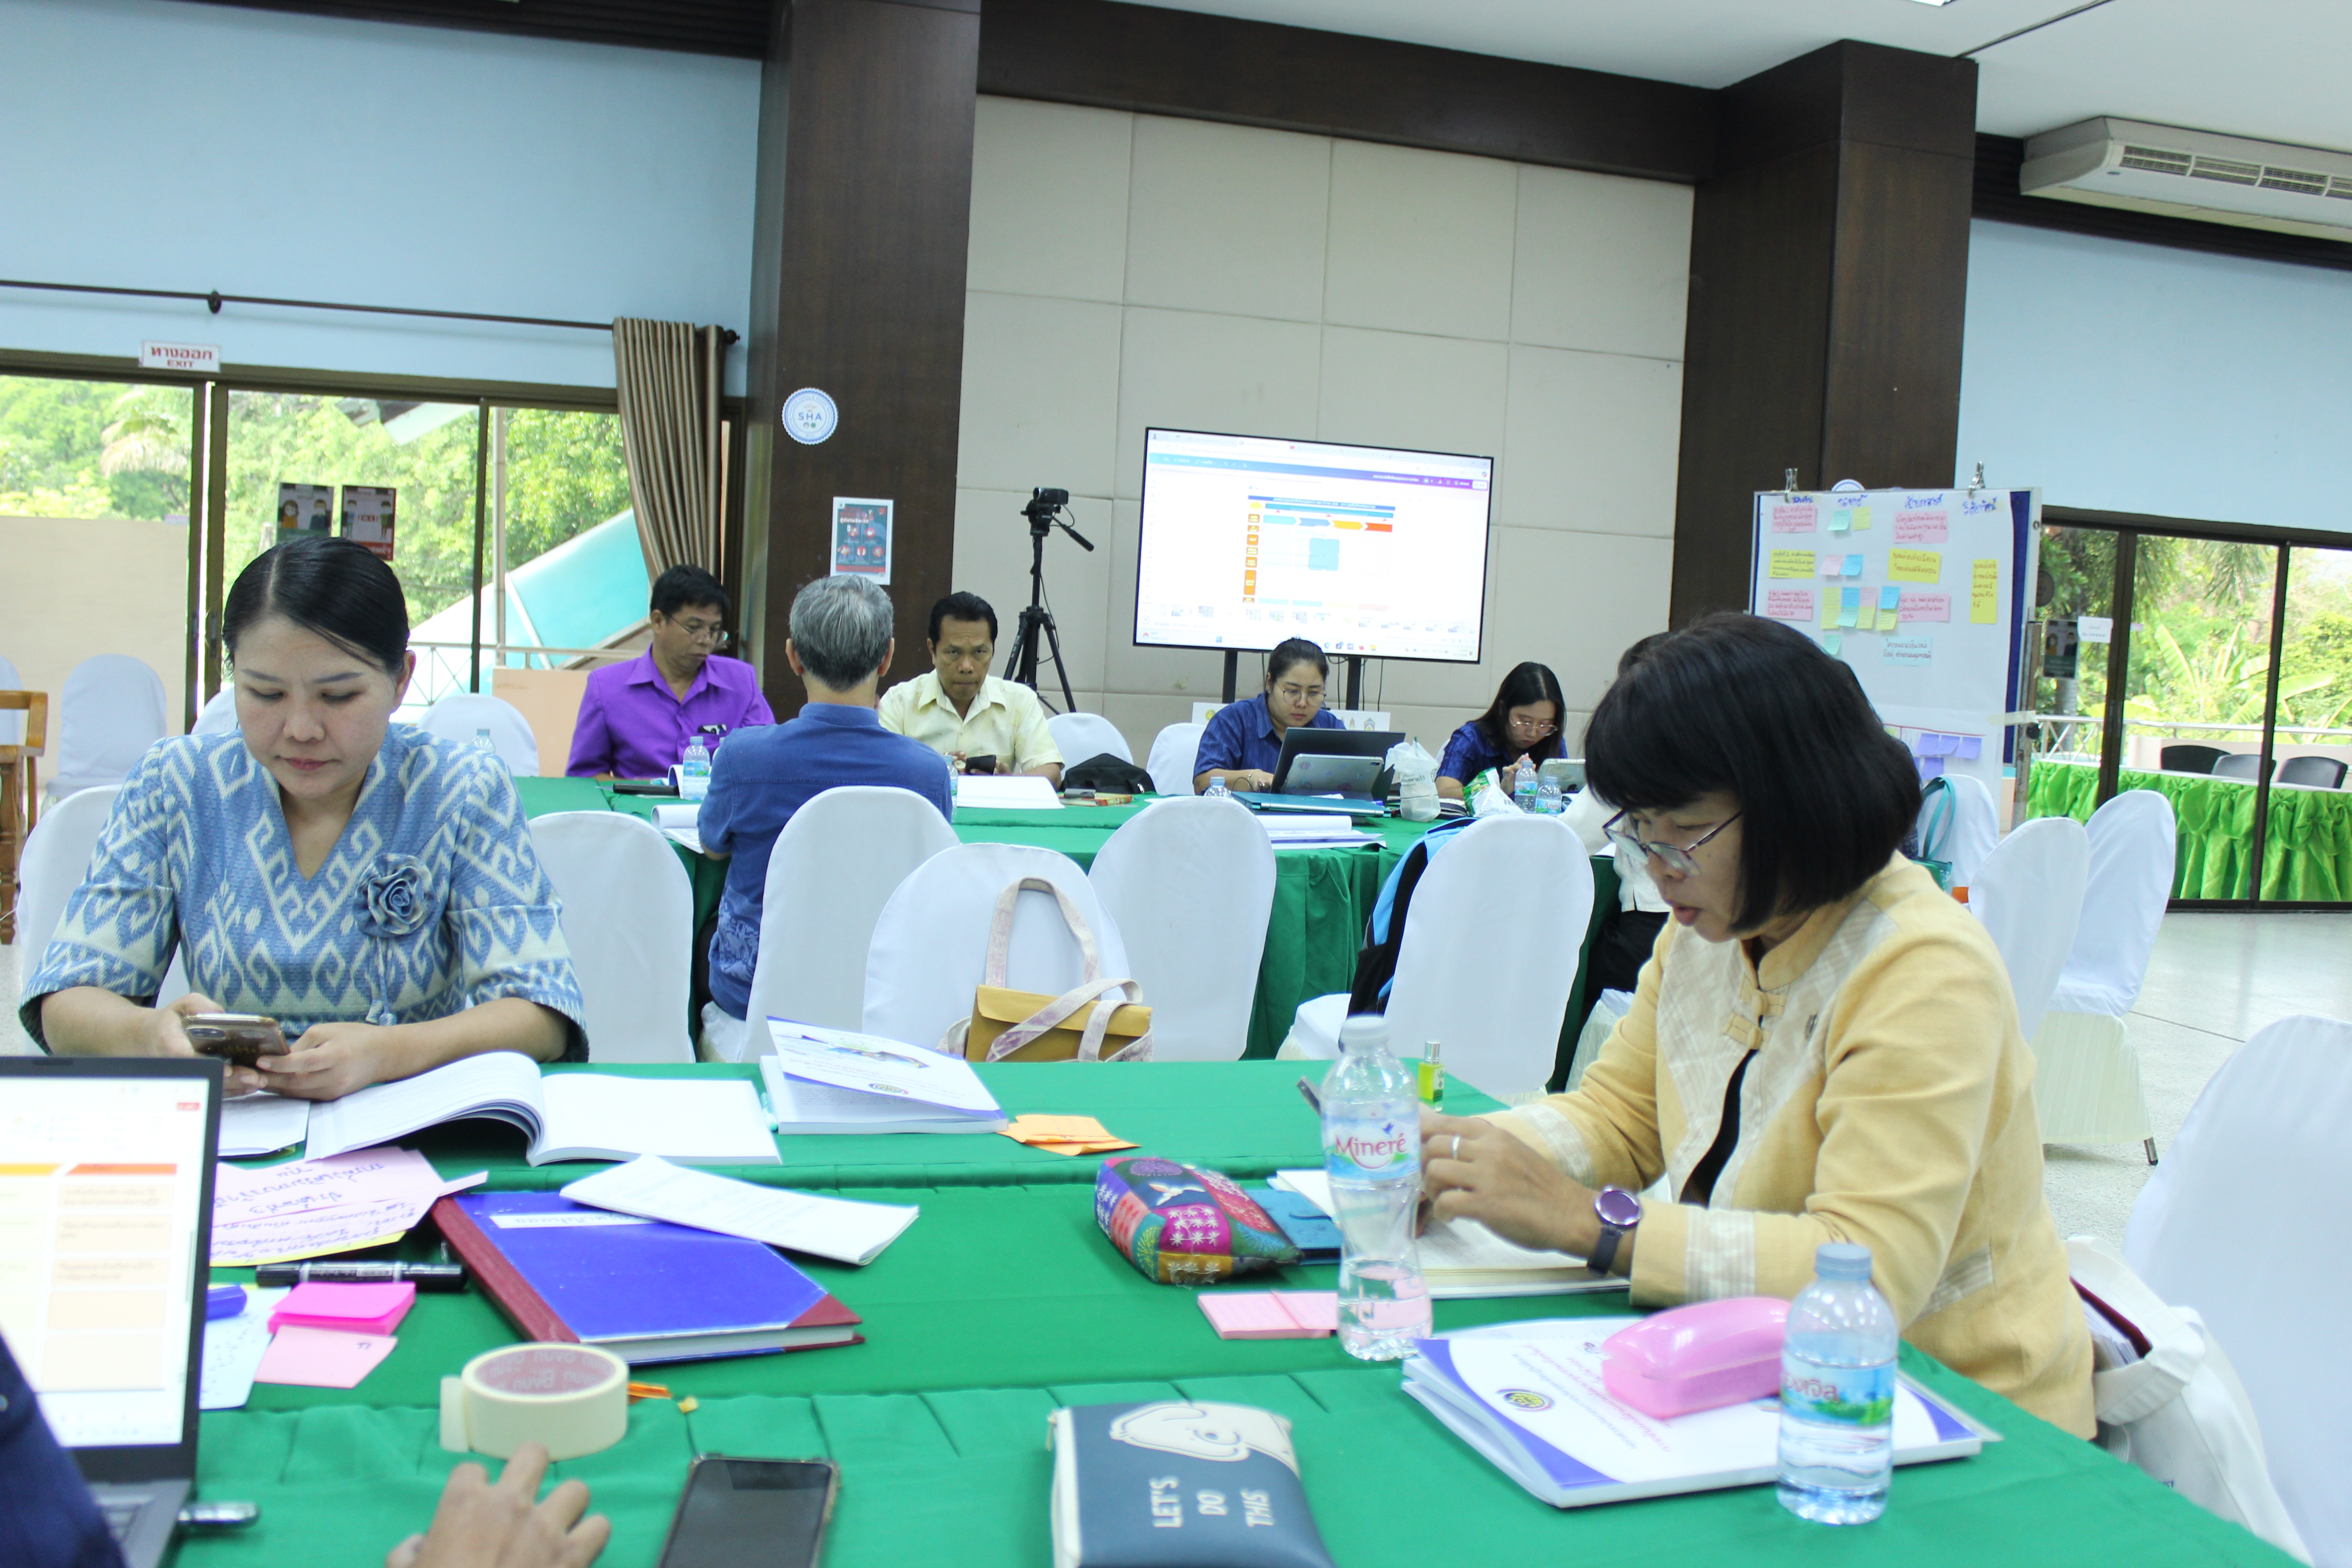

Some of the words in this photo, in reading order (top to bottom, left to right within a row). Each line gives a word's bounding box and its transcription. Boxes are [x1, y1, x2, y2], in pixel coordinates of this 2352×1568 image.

[151, 346, 213, 360] ทางออก
[167, 360, 194, 368] EXIT
[798, 412, 822, 421] SHA
[1334, 1132, 1407, 1161] Mineré
[533, 1350, 575, 1363] nuvo
[1149, 1475, 1184, 1529] LET'S
[1196, 1490, 1229, 1516] DO
[1240, 1487, 1275, 1528] THIS
